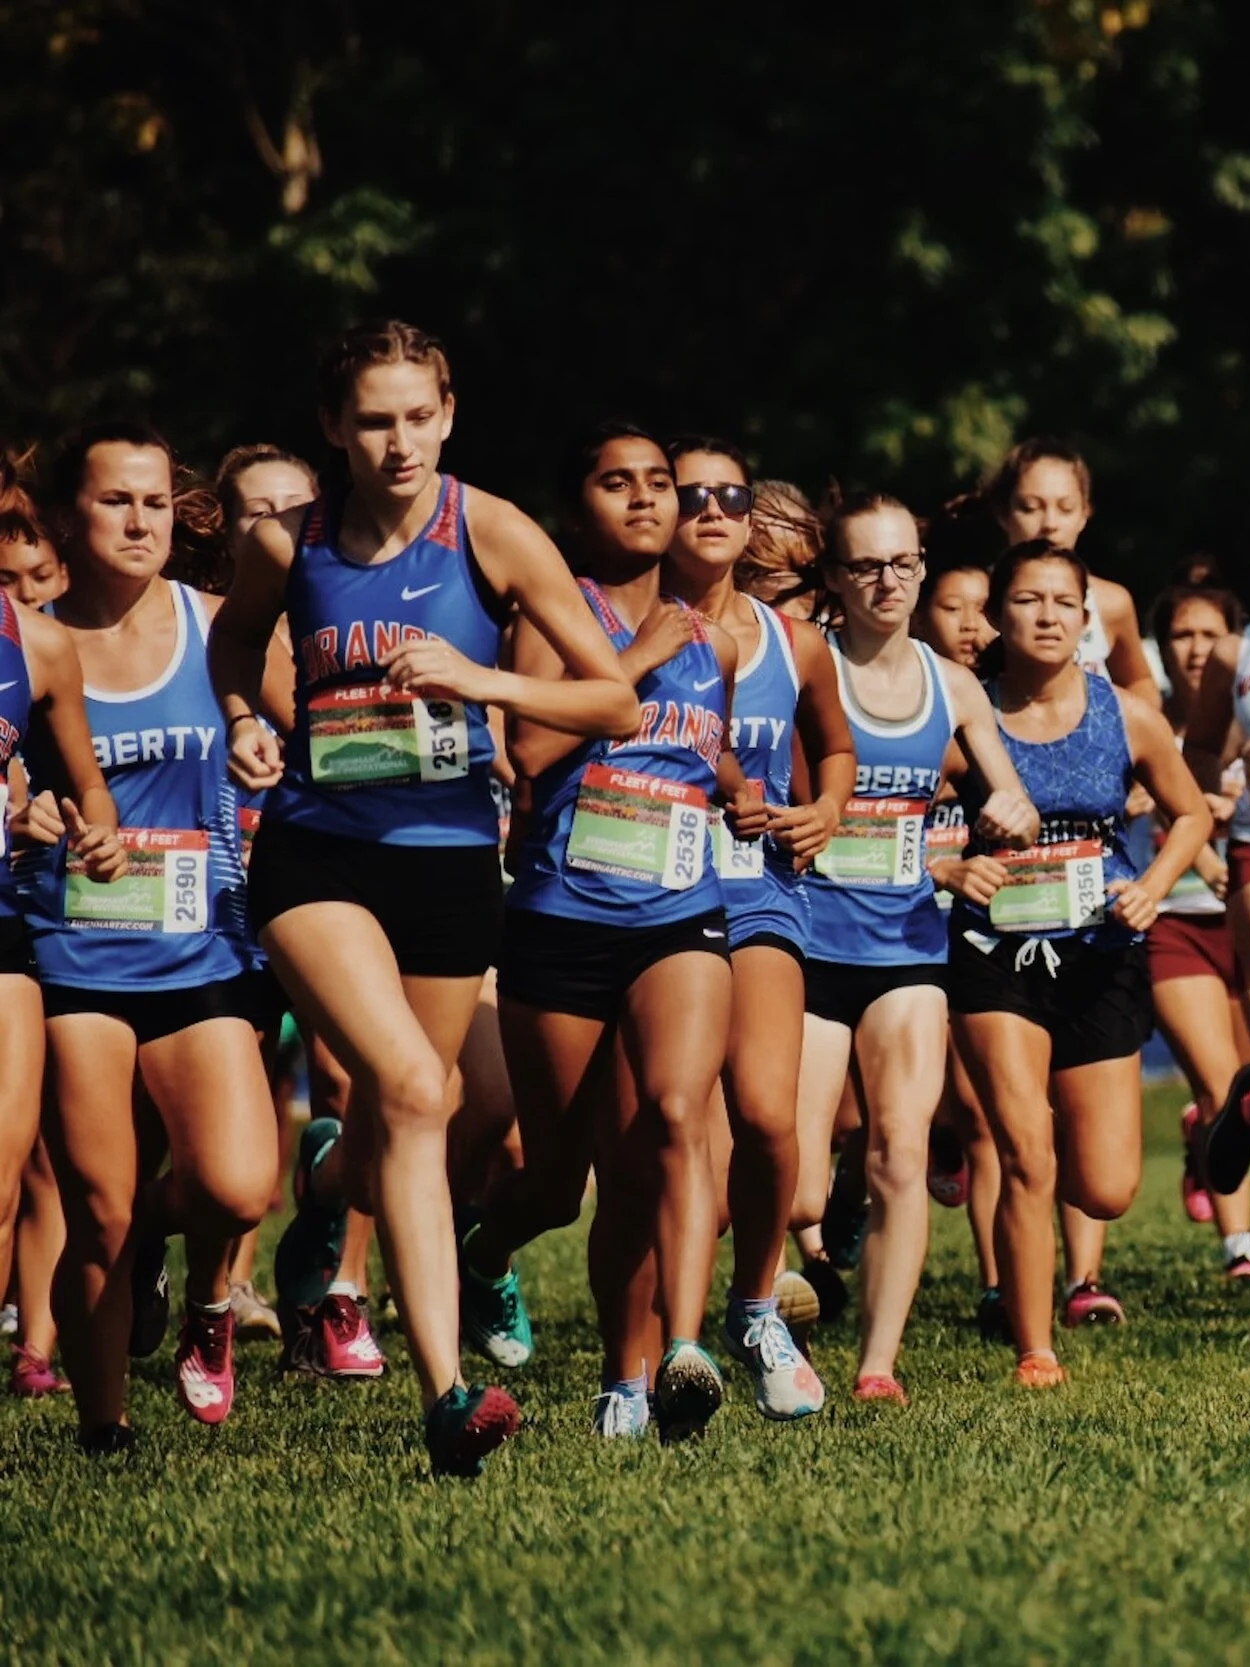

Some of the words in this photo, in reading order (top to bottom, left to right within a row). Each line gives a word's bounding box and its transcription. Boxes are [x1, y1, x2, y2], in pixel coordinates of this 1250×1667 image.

[301, 620, 440, 685] ORAN
[609, 773, 649, 789] FLEET
[660, 783, 689, 800] FEET
[150, 833, 181, 845] FEET
[675, 811, 698, 881] 2536
[900, 821, 917, 875] 2570
[175, 856, 197, 922] 2590
[1077, 863, 1097, 917] 2356
